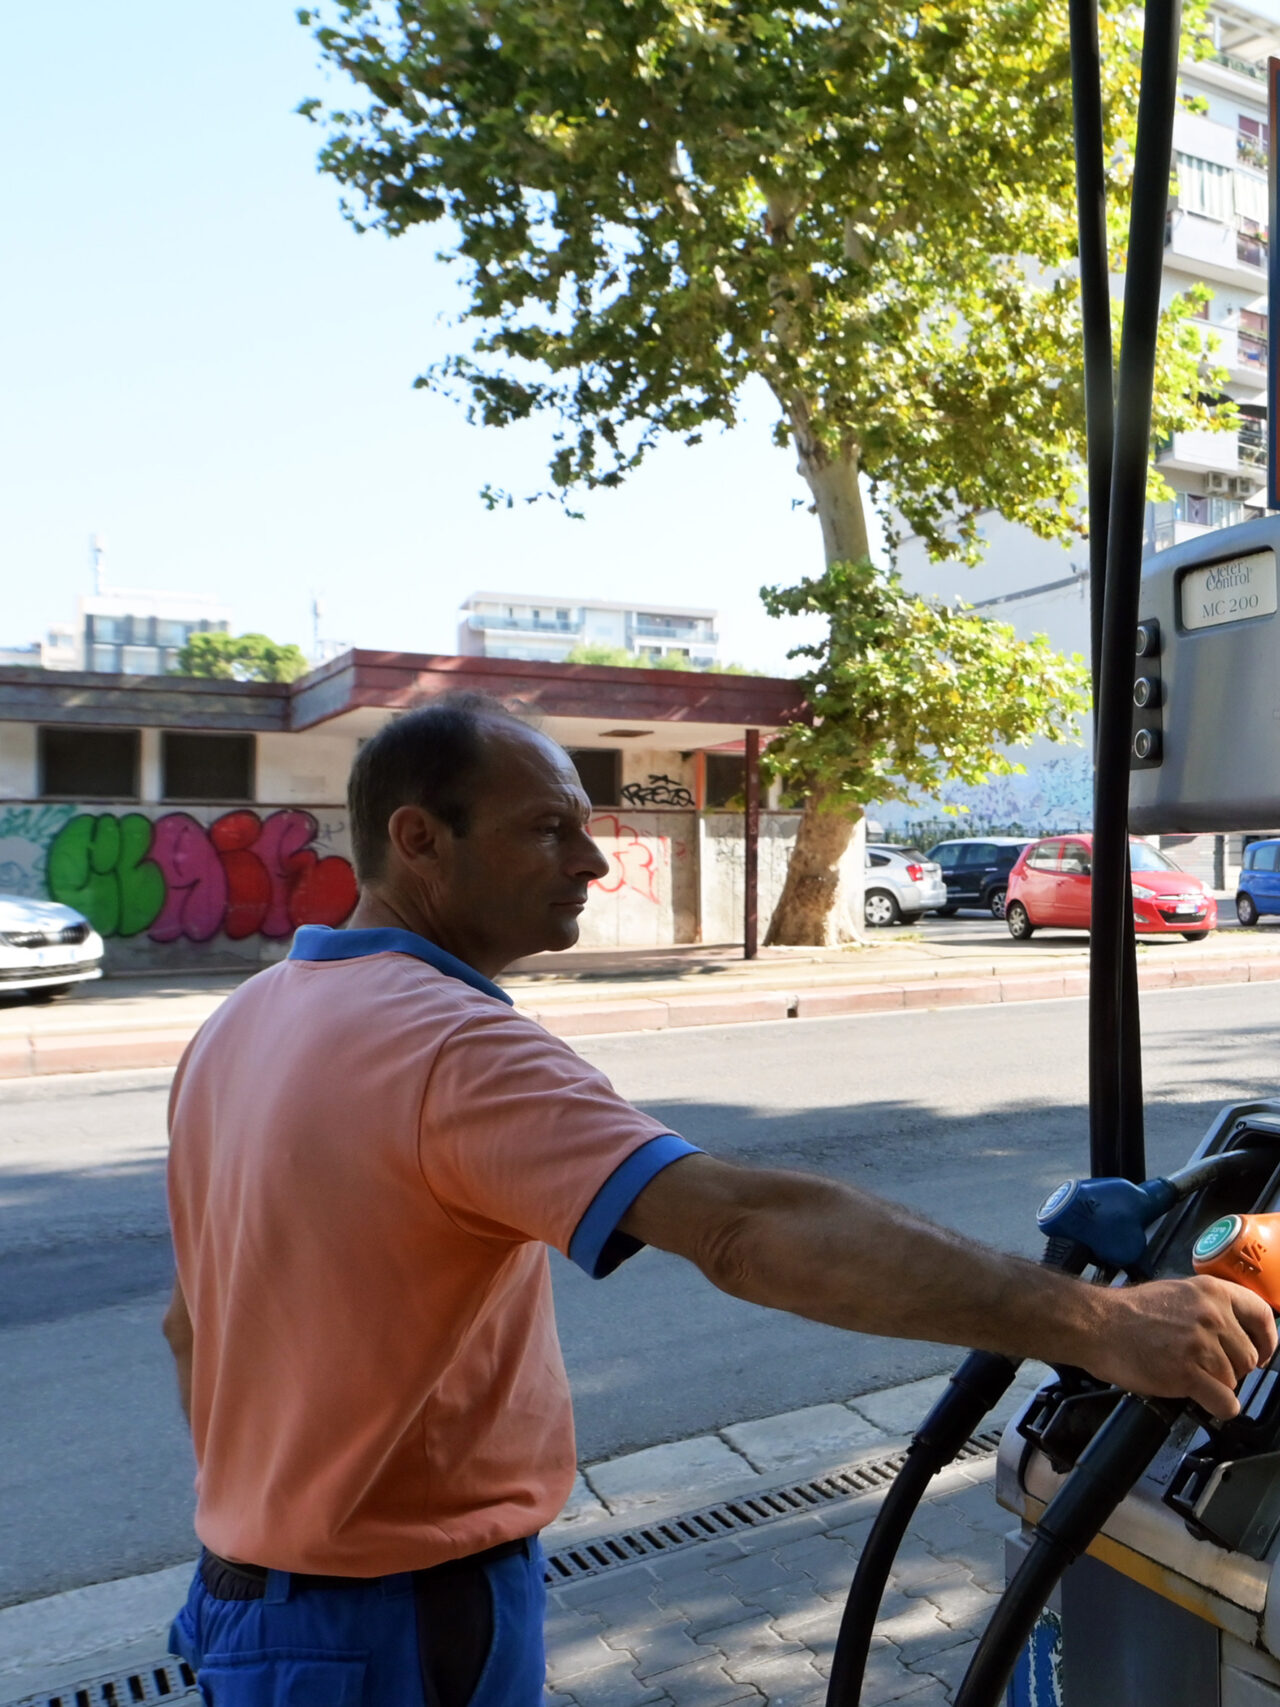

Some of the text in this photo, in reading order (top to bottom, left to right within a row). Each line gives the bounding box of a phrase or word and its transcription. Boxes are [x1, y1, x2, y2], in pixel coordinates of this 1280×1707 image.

[1206, 568, 1252, 592] Control
[1202, 594, 1259, 618] MC 200
